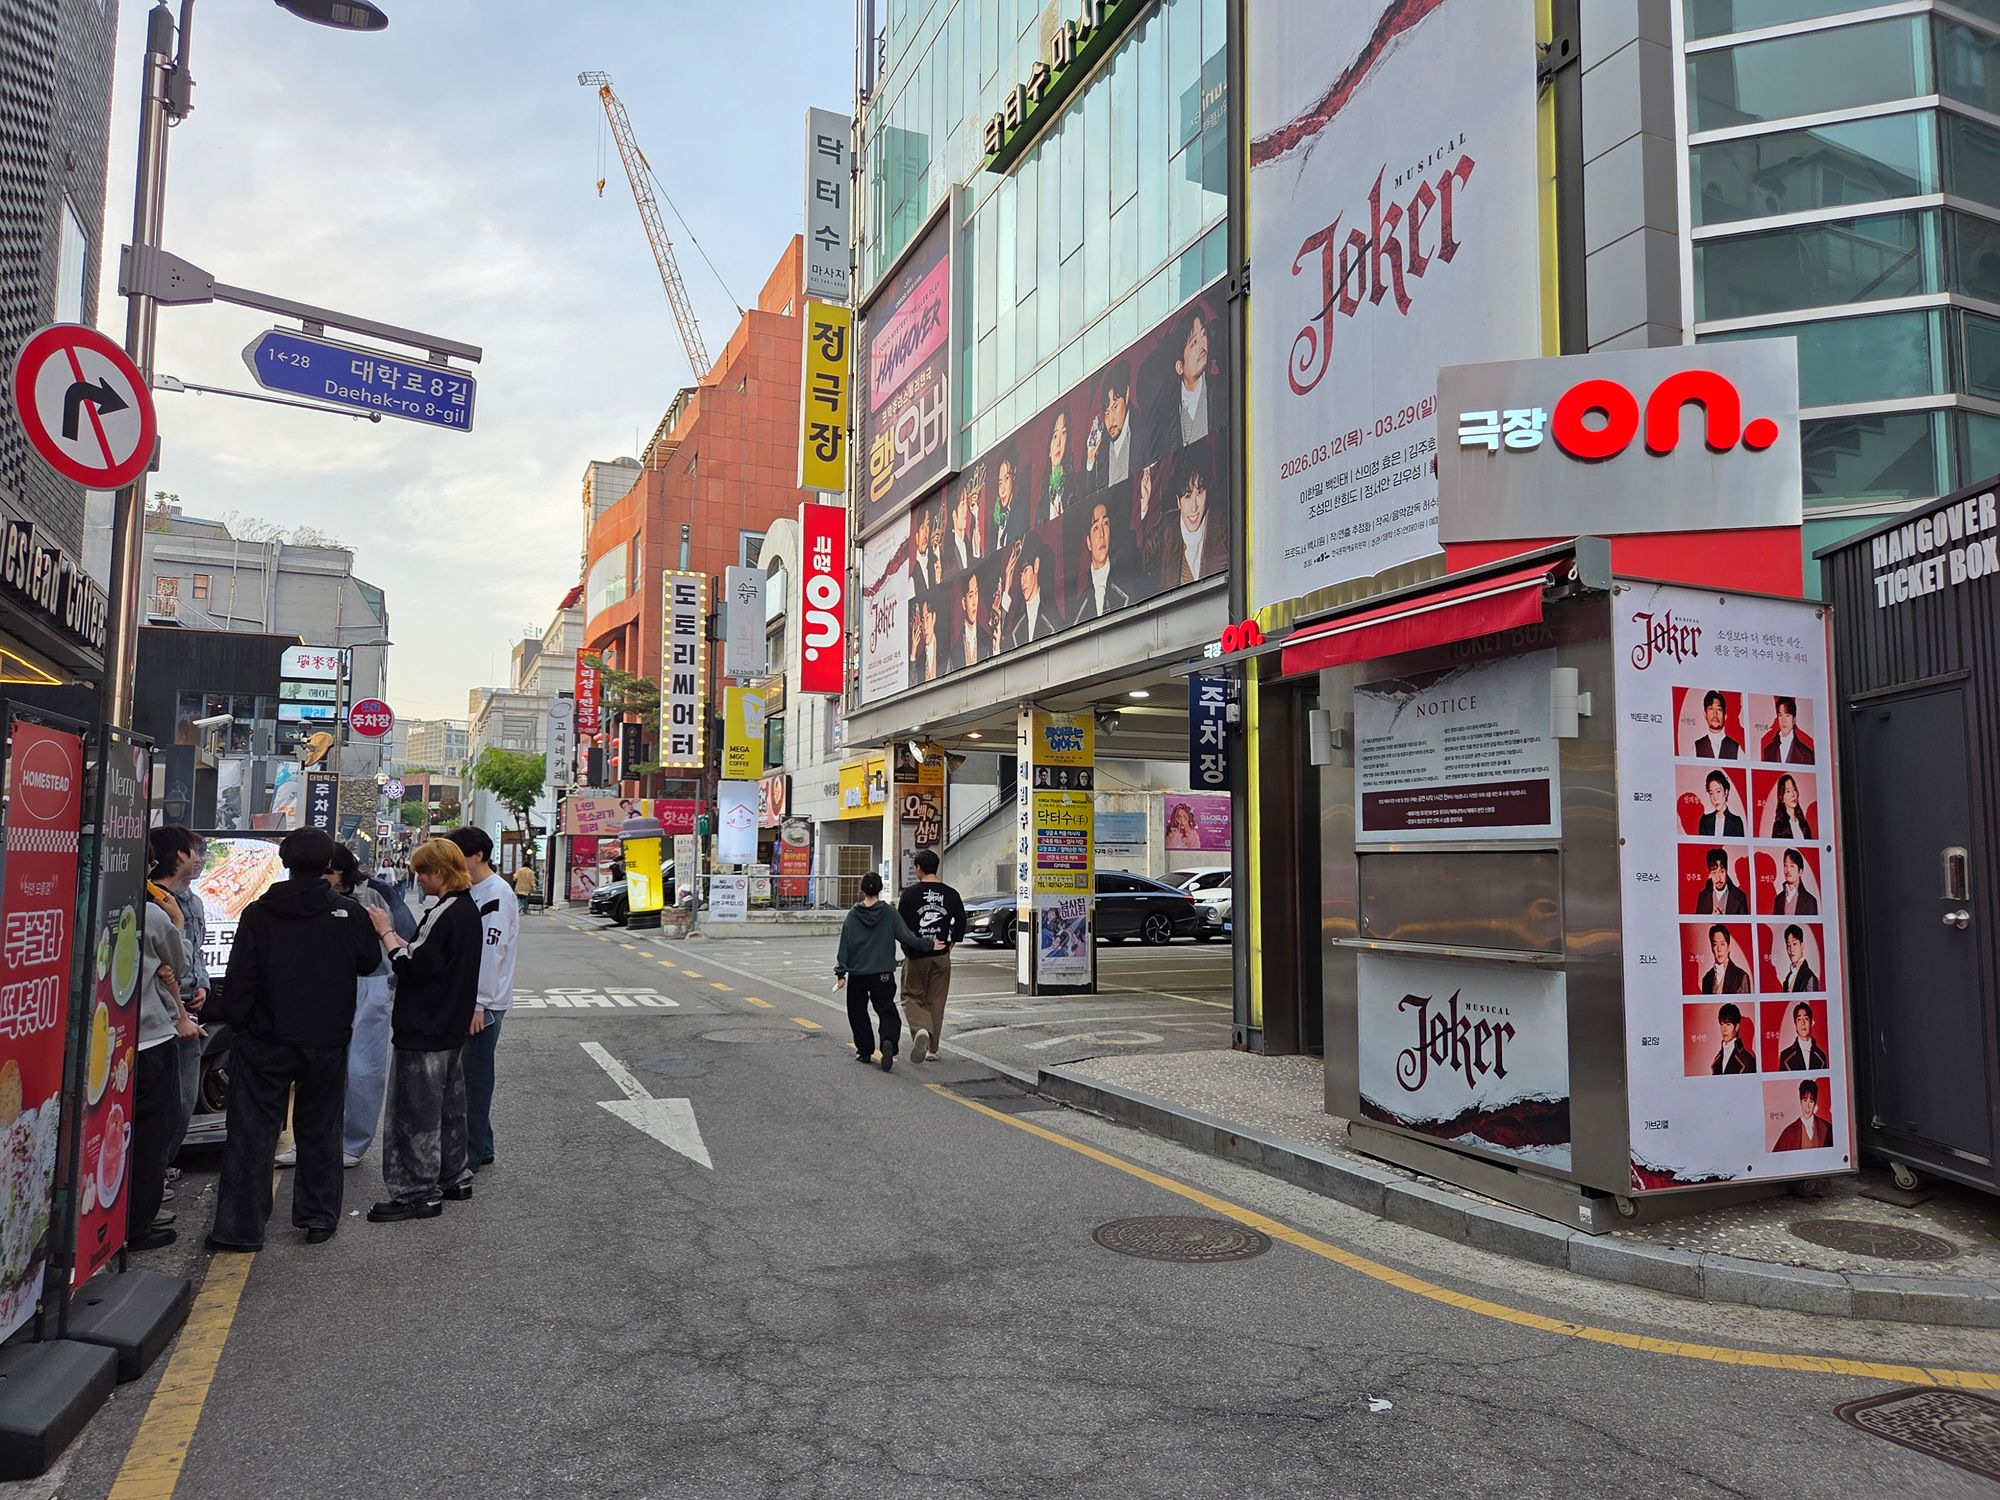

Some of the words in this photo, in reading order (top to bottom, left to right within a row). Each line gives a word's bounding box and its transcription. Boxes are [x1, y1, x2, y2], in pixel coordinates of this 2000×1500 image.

[983, 61, 1050, 155] 닥터수
[1050, 0, 1118, 72] 마사
[1394, 132, 1466, 190] MUSICAL
[815, 135, 844, 251] 닥터수
[812, 264, 845, 281] 마사지
[1288, 154, 1475, 395] Joker
[876, 297, 941, 397] HANGOVER
[325, 379, 420, 413] Daehak-ro
[425, 402, 465, 424] 8-gil
[351, 359, 468, 406] 대학로8길
[809, 321, 847, 462] 정극장
[869, 371, 948, 502] 행오버
[1281, 428, 1363, 479] 2026.03.12(목)
[1375, 394, 1437, 438] 03.29(일)
[1458, 407, 1548, 450] 극장
[1308, 499, 1333, 519] 조성민
[1364, 476, 1390, 499] 정서안
[1393, 467, 1421, 487] 김우성
[1355, 460, 1380, 480] 신의정
[813, 535, 831, 574] 극장
[1872, 493, 1997, 570] HANGOVER
[1874, 554, 1945, 608] TICKET
[1949, 536, 2000, 585] BOX
[870, 594, 897, 653] Joker
[1631, 609, 1702, 670] Joker
[1717, 630, 1748, 642] 소설보다
[1751, 632, 1759, 643] 더
[1762, 634, 1784, 646] 잔인한
[672, 584, 697, 755] 도토리씨어터
[1733, 646, 1748, 658] 들어
[1752, 648, 1774, 660] 복수의
[353, 714, 390, 727] 주차장
[1416, 695, 1477, 717] NOTICE
[554, 722, 568, 781] 고씨네카레
[1199, 686, 1227, 784] 주차장
[22, 769, 70, 792] HOMESTEAD
[575, 801, 595, 812] 너의
[1635, 872, 1660, 882] 우르수스
[1639, 954, 1658, 965] 조나스
[1465, 1003, 1511, 1015] MUSICAL
[1396, 988, 1516, 1092] Joker
[1644, 1120, 1669, 1131] 가브리엘
